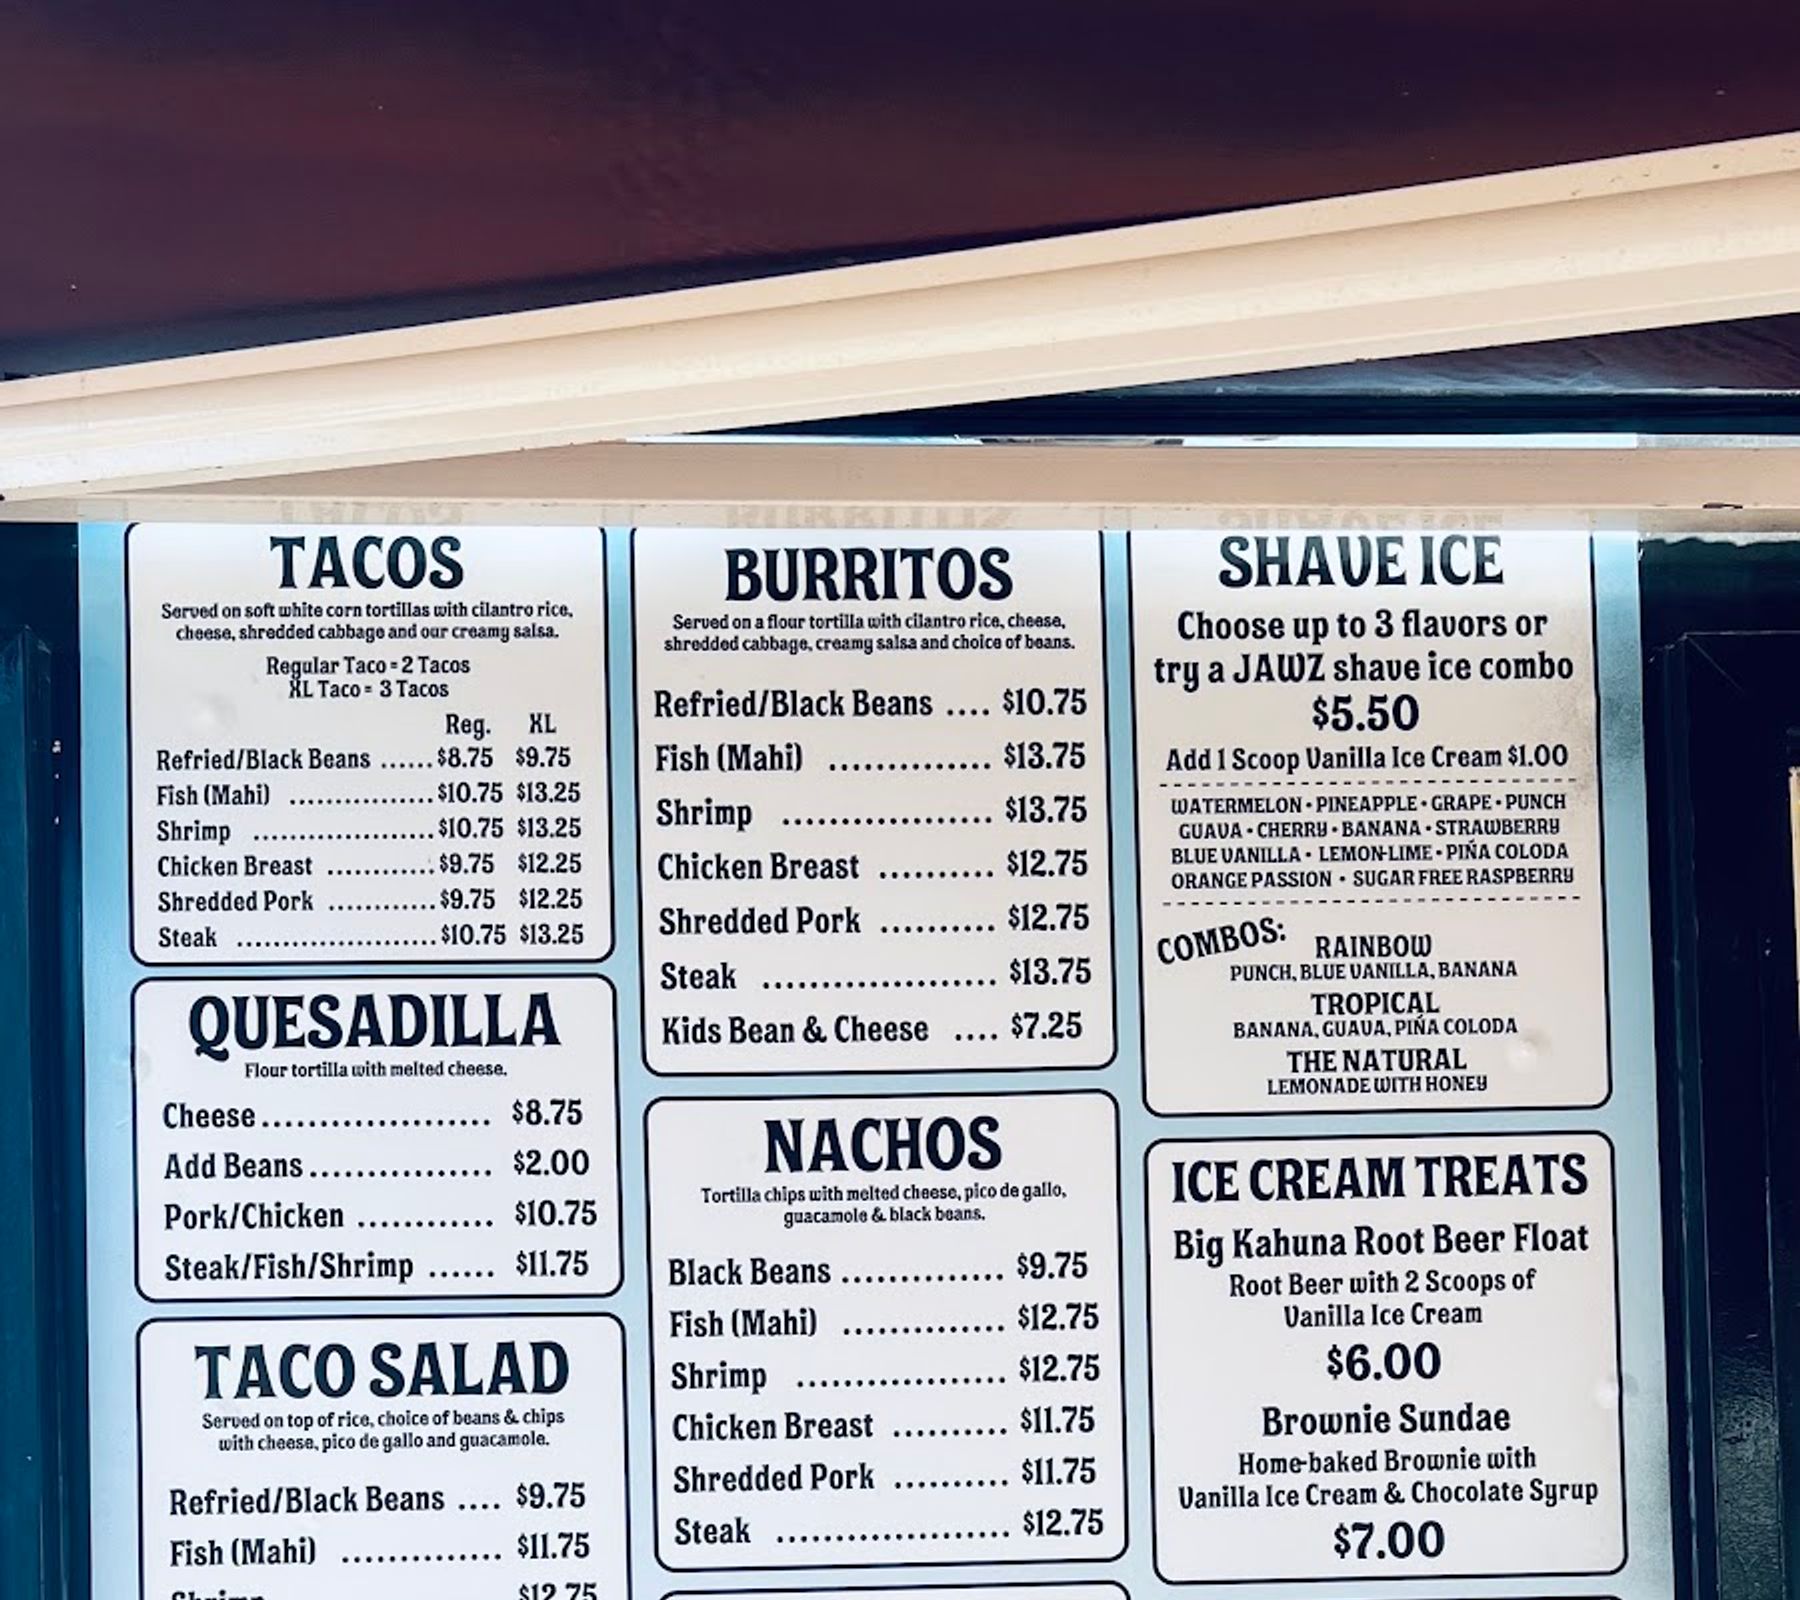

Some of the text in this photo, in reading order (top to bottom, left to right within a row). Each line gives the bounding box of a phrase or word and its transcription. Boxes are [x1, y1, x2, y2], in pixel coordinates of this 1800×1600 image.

[269, 535, 463, 589] TACOS
[724, 547, 1012, 601] BURRITOS
[1218, 534, 1503, 588] SHAVE ICE
[161, 600, 573, 619] Served on soft white corn tortillas with cilantro rice,
[672, 611, 1065, 629] Served on a flour tortilla with cilantro rice, cheese,
[1177, 608, 1547, 645] Choose up to 3 flavors or
[445, 712, 556, 738] Reg. XL
[1312, 693, 1419, 731] $5.50
[156, 748, 303, 771] Refried/Black
[307, 747, 370, 769] Beans
[515, 745, 571, 767] $9.75
[1171, 793, 1565, 814] WATERMELON PINEAPPLE GRAPE PUNCH
[657, 849, 1087, 881] Chicken Breast $12.75
[1171, 867, 1573, 889] ORANGE PASSION SUGAR FREE RASPBERRY
[1157, 916, 1285, 964] COMBOS:
[1315, 933, 1431, 959] RAINBOW
[1230, 960, 1517, 981] PUNCH, BLUE VANILLA, BANANA
[188, 991, 561, 1062] QUESADILLA
[661, 1011, 1082, 1045] Kids Bean & Cheese $7.25
[244, 1060, 507, 1077] Flour tortilla with melted cheese.
[162, 1098, 582, 1129] Cheese $8.75
[763, 1115, 1001, 1173] NACHOS
[1171, 1152, 1588, 1203] ICE CREAM TREATS
[783, 1205, 985, 1229] guacamole & black beans.
[1173, 1222, 1588, 1267] Big Kahuna Root Beer Float
[165, 1249, 588, 1284] Steak/Fish/Shrimp $11.75
[194, 1340, 569, 1399] TACO SALAD
[671, 1353, 1099, 1394] Shrimp $12.75
[1326, 1341, 1440, 1381] $6.00
[201, 1407, 565, 1431] Served on top of rice, choice of beans & chips
